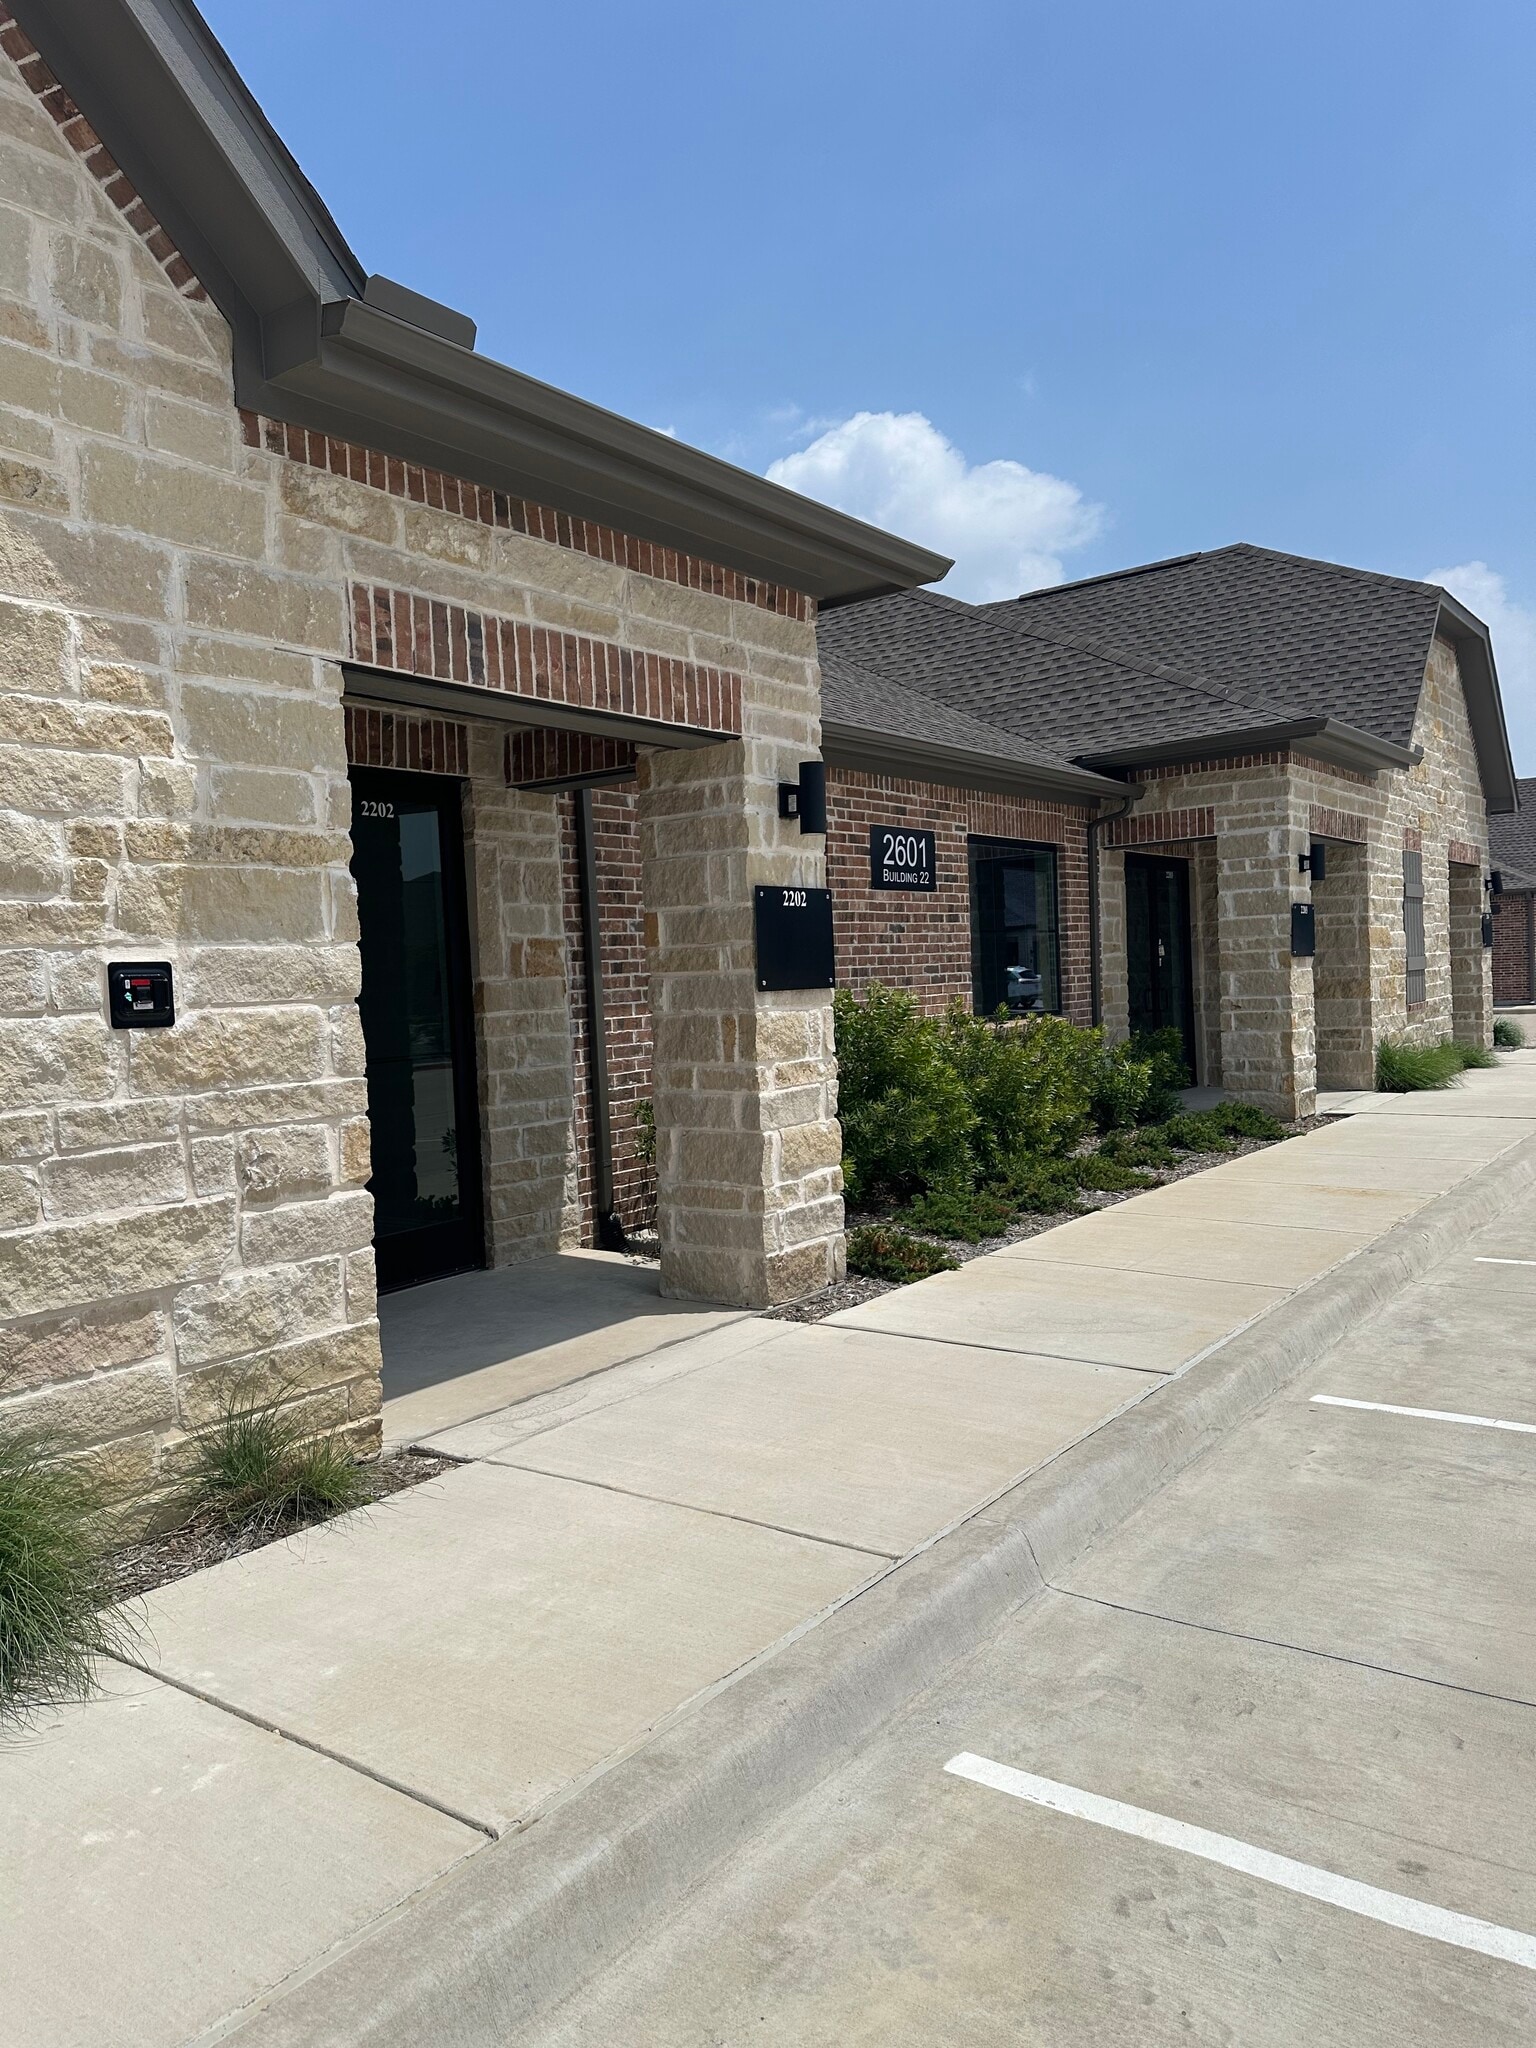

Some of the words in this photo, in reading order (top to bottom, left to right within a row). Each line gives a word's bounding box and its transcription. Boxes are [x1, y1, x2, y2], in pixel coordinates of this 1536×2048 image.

[361, 800, 395, 819] 2202
[883, 833, 927, 868] 2601
[883, 868, 918, 884] BUILDING
[919, 871, 930, 884] 22
[782, 890, 808, 907] 2202
